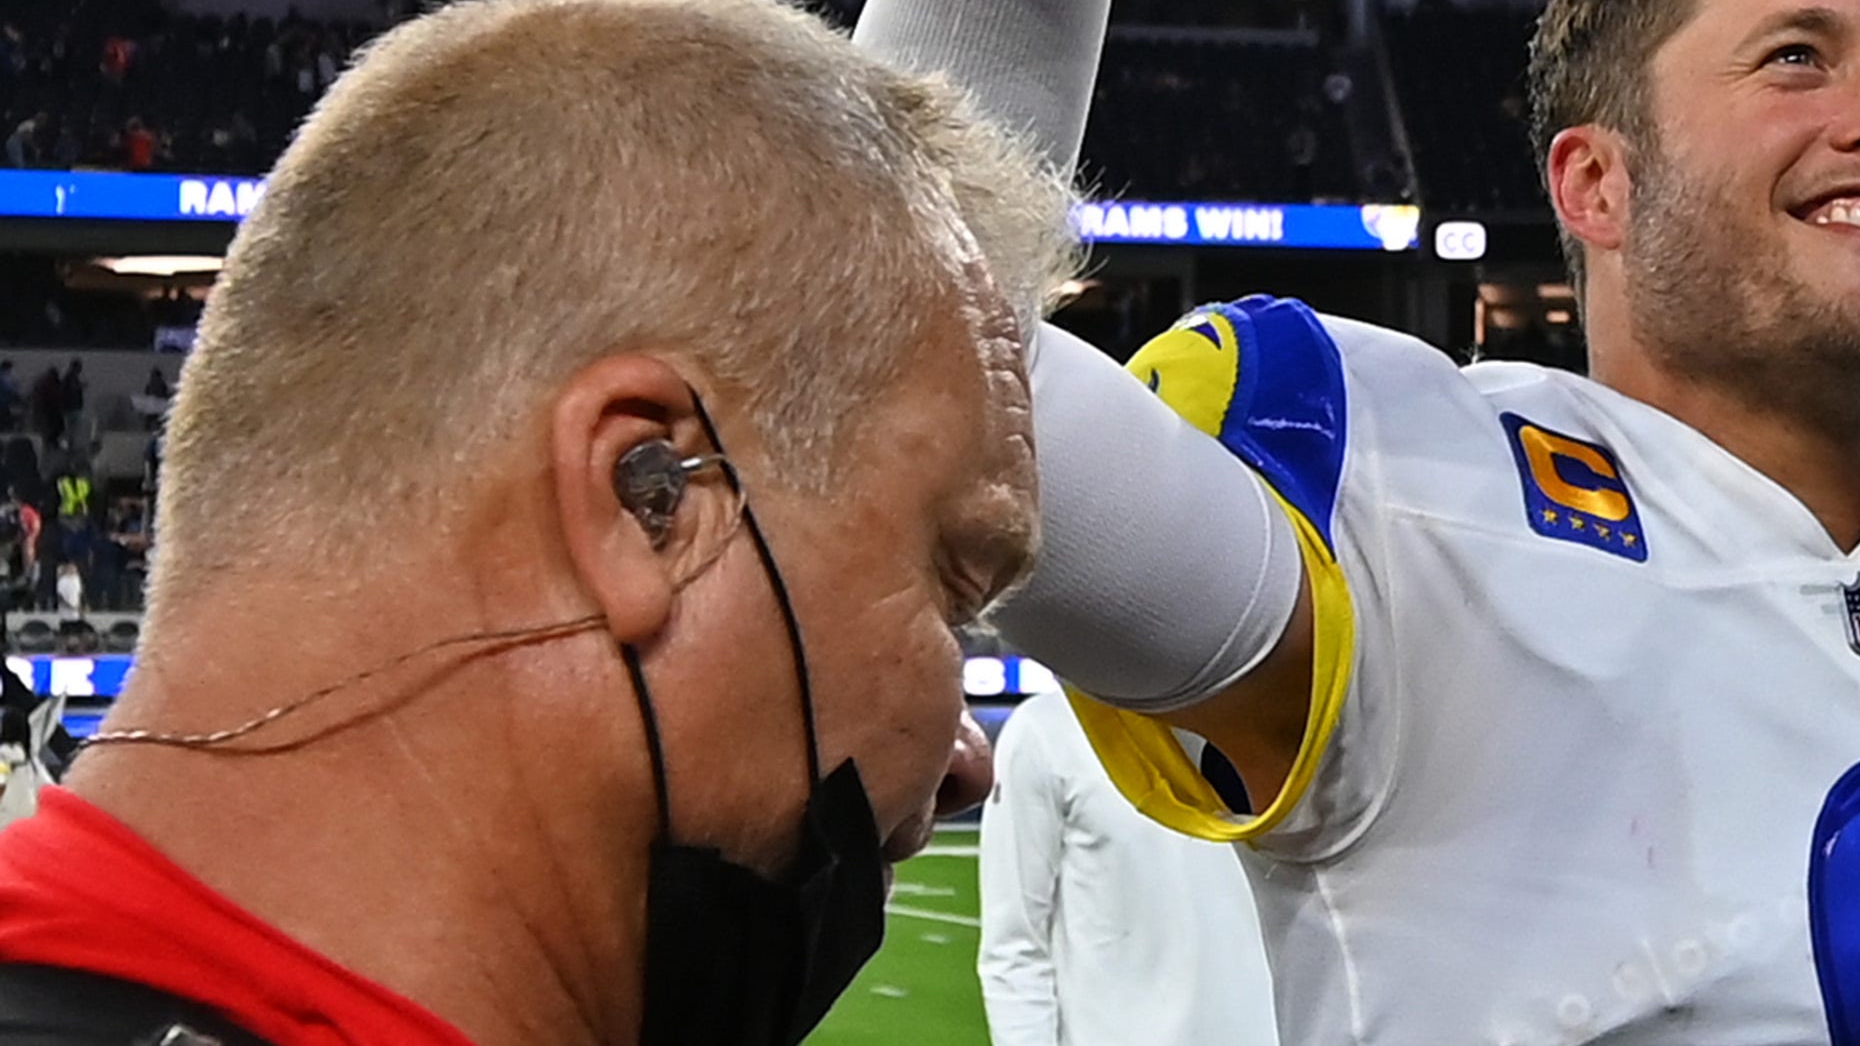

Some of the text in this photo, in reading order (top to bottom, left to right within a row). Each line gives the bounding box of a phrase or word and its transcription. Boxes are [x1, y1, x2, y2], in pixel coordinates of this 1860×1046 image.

[180, 179, 268, 215] RAM
[1081, 205, 1283, 241] RAMS WIN!
[1518, 424, 1631, 521] C
